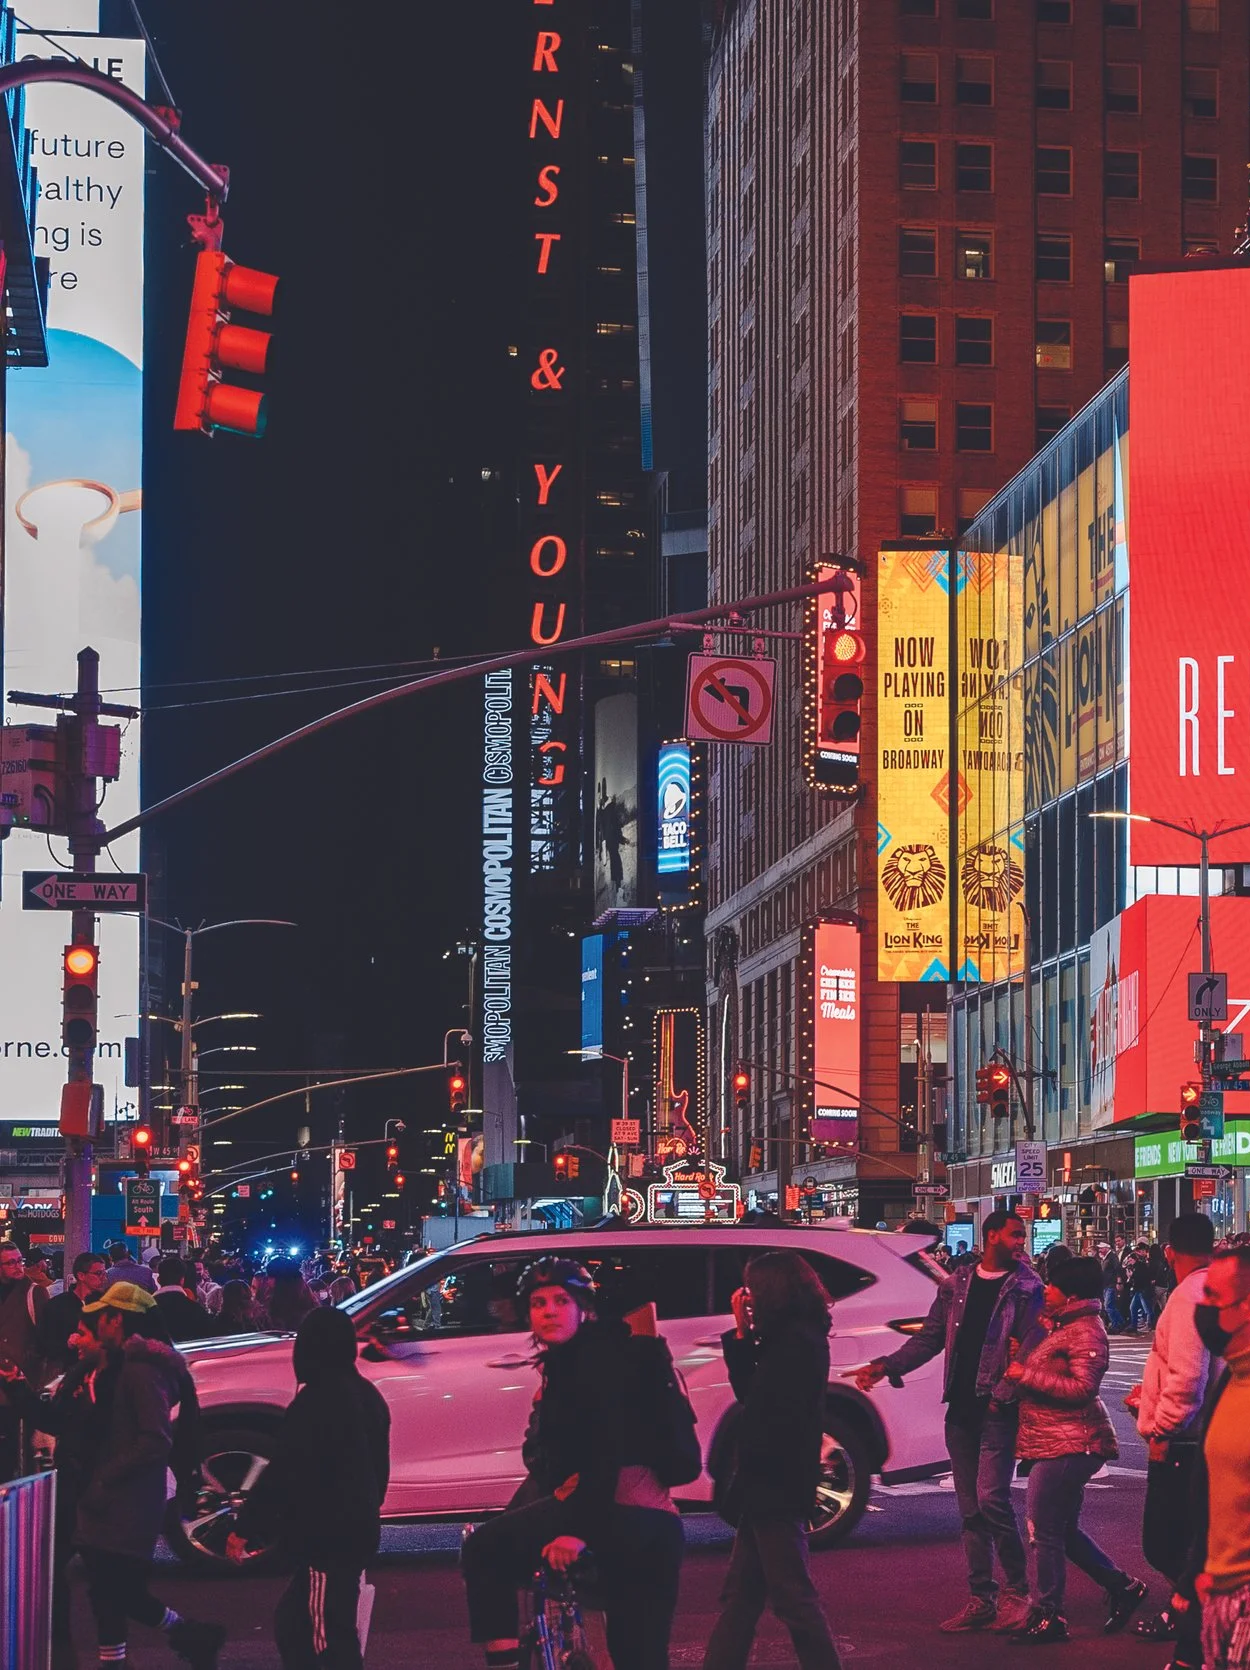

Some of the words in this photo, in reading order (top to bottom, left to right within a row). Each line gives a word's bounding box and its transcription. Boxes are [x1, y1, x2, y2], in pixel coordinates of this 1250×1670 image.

[31, 129, 125, 159] future
[529, 0, 563, 275] RNST
[80, 221, 103, 247] is
[530, 347, 565, 391] &
[1088, 503, 1114, 580] THE
[894, 636, 935, 668] NOW
[884, 671, 945, 698] PLAYING
[903, 709, 924, 737] ON
[882, 749, 944, 770] BROADWAY
[662, 821, 687, 836] TACO
[663, 835, 688, 850] BELL
[482, 789, 513, 941] COSMOPOLITAN
[42, 884, 76, 899] ONE
[93, 885, 130, 899] WAY
[884, 932, 911, 949] LION
[912, 932, 943, 949] KING
[820, 1001, 856, 1020] Meals
[1194, 1008, 1222, 1017] ONLY
[674, 1172, 694, 1182] Hard
[1020, 1162, 1044, 1177] 25
[1191, 1167, 1205, 1175] ONE
[1211, 1167, 1226, 1175] WAY
